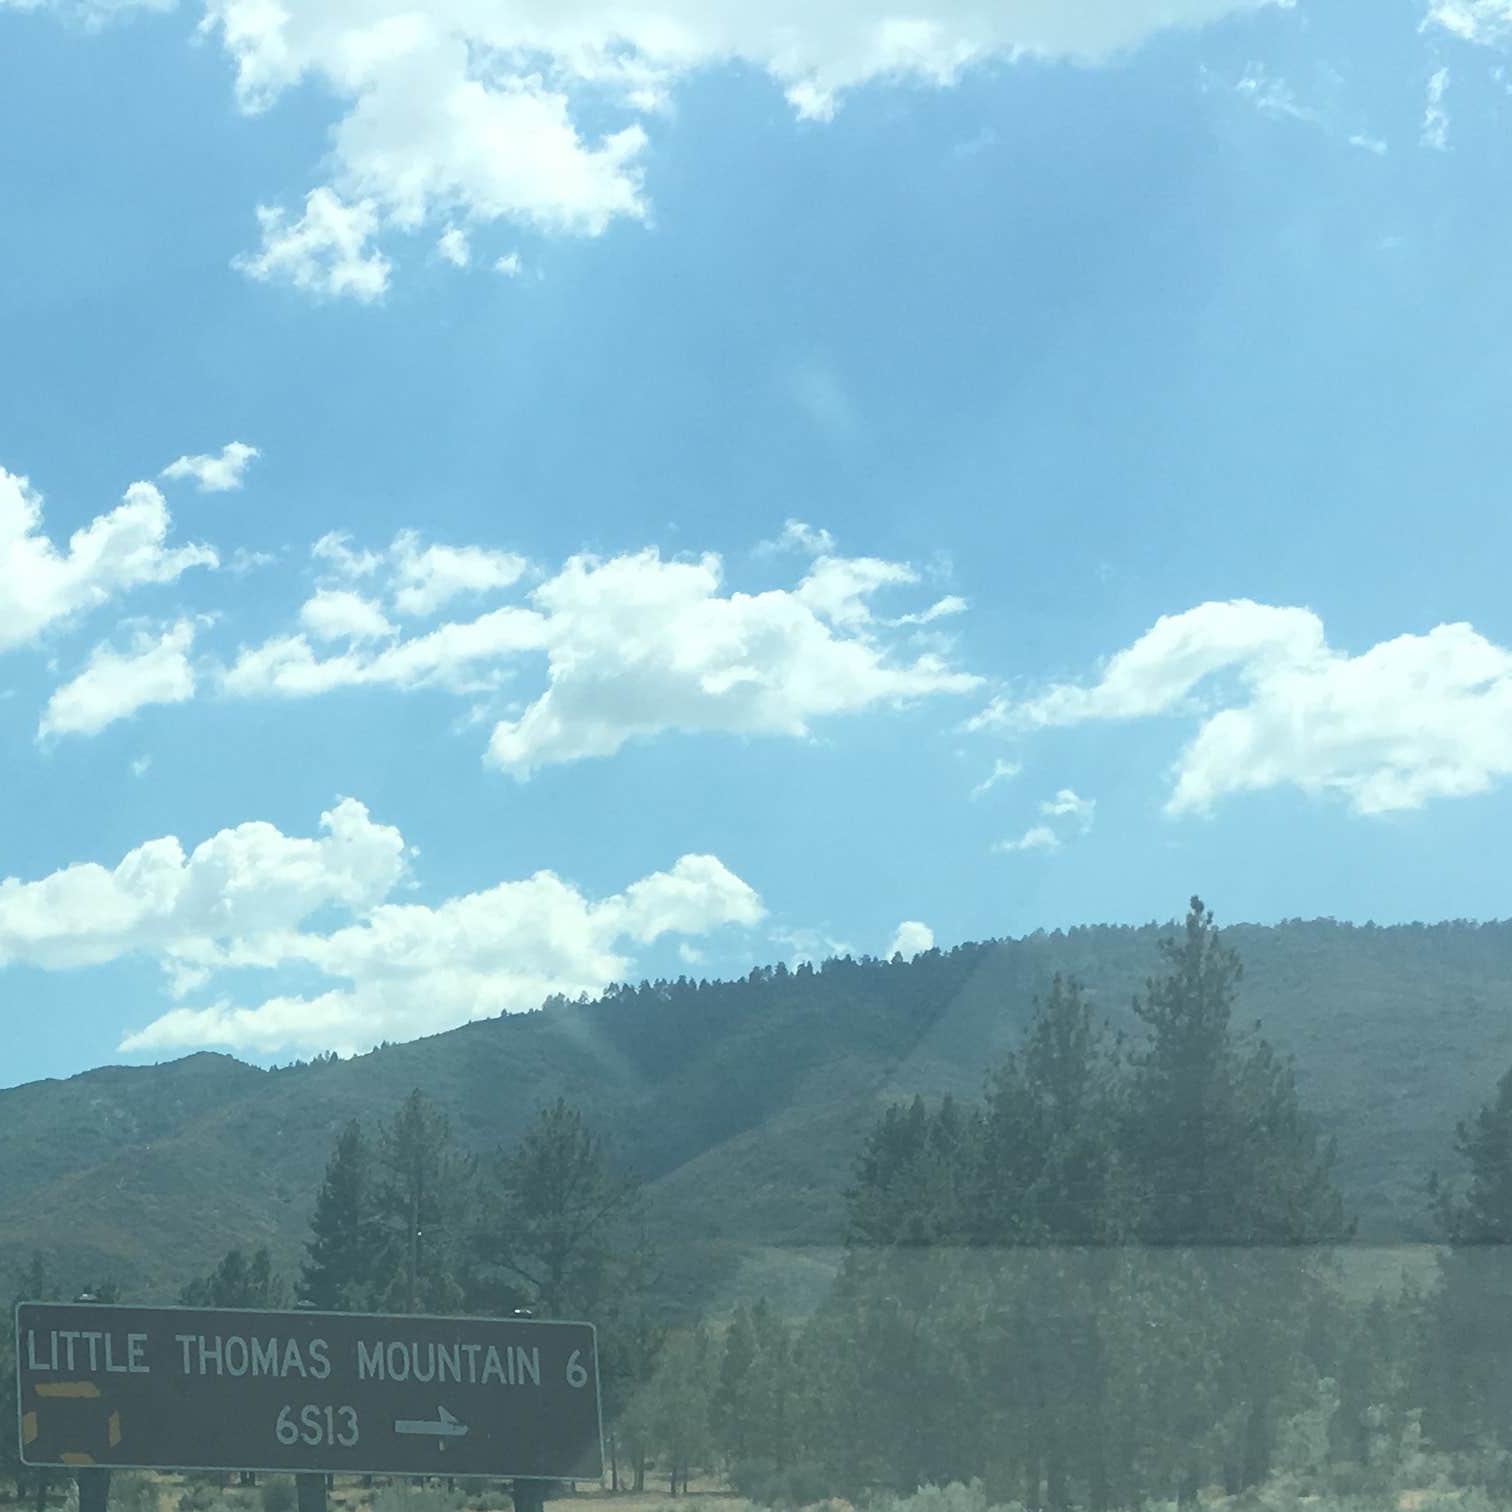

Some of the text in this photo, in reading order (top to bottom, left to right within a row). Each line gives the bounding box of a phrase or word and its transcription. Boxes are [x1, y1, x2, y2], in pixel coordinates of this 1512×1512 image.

[27, 1329, 588, 1388] LITTLE THOMAS MOUNTAIN 6
[275, 1405, 360, 1447] 6S13
